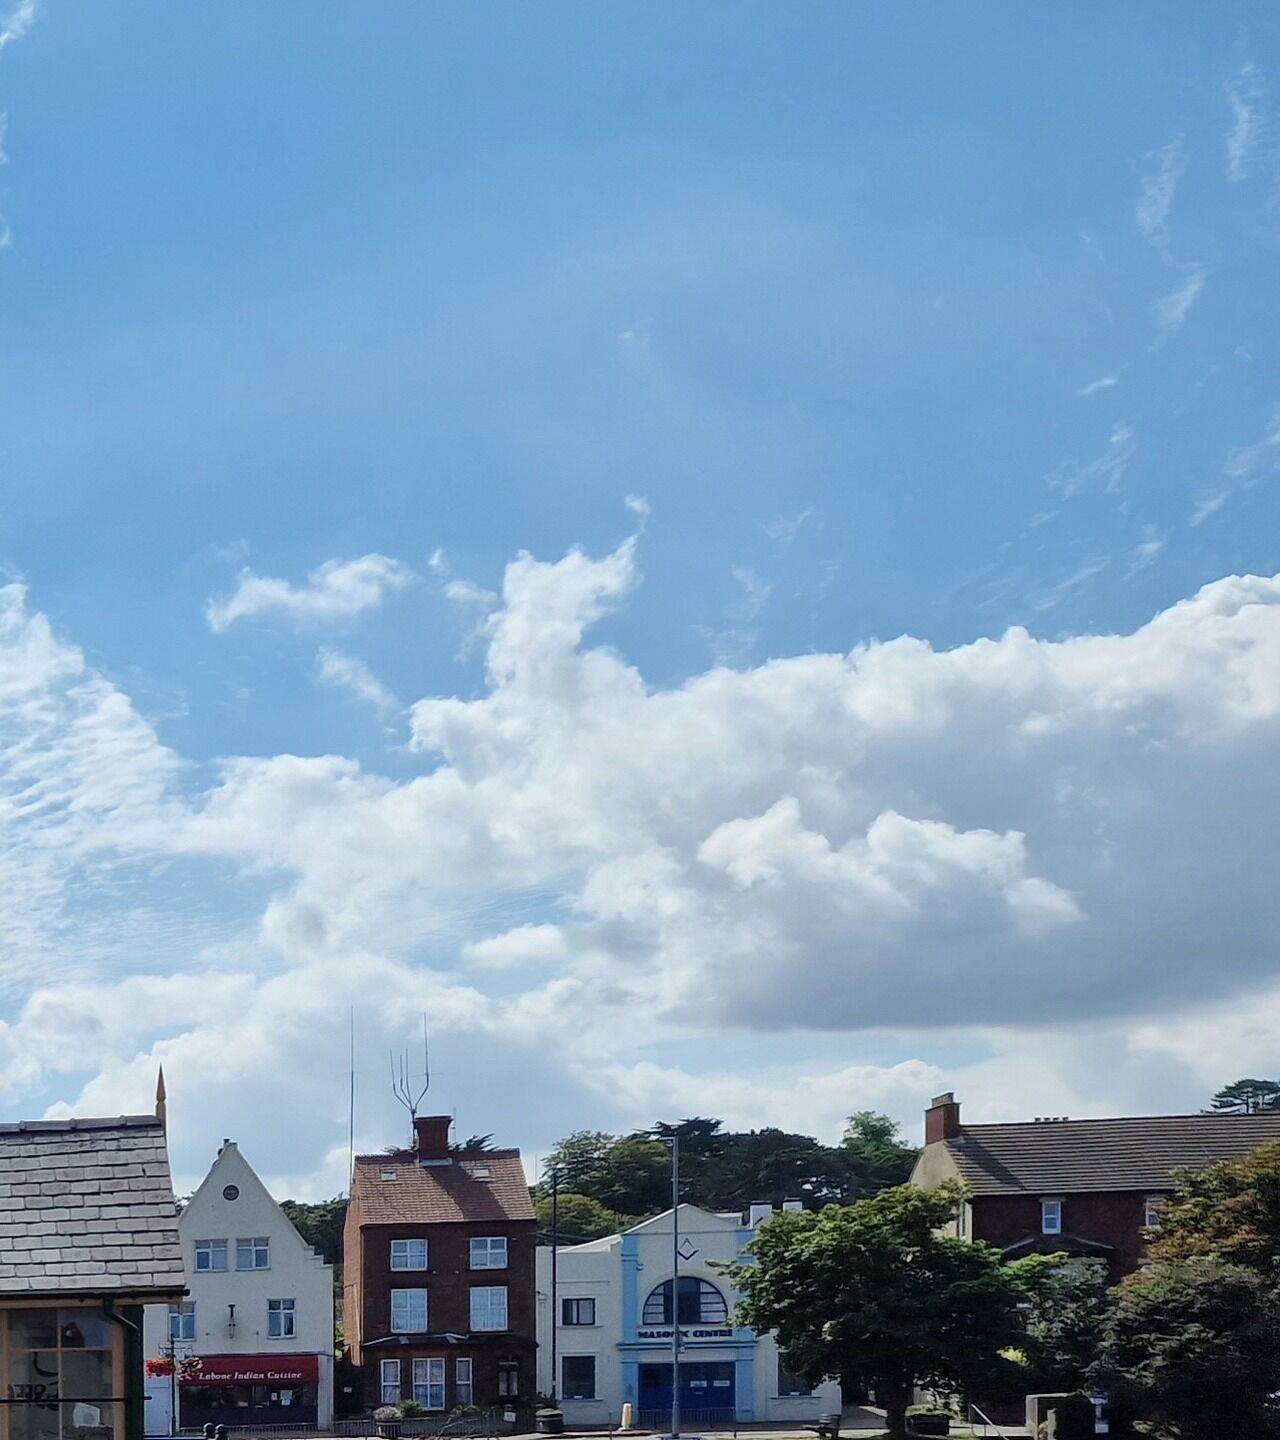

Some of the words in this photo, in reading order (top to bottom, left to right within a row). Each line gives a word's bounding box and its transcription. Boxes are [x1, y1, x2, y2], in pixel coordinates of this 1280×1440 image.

[693, 1329, 733, 1338] CENTRE
[234, 1371, 264, 1379] Indian
[267, 1371, 302, 1379] Cuisine
